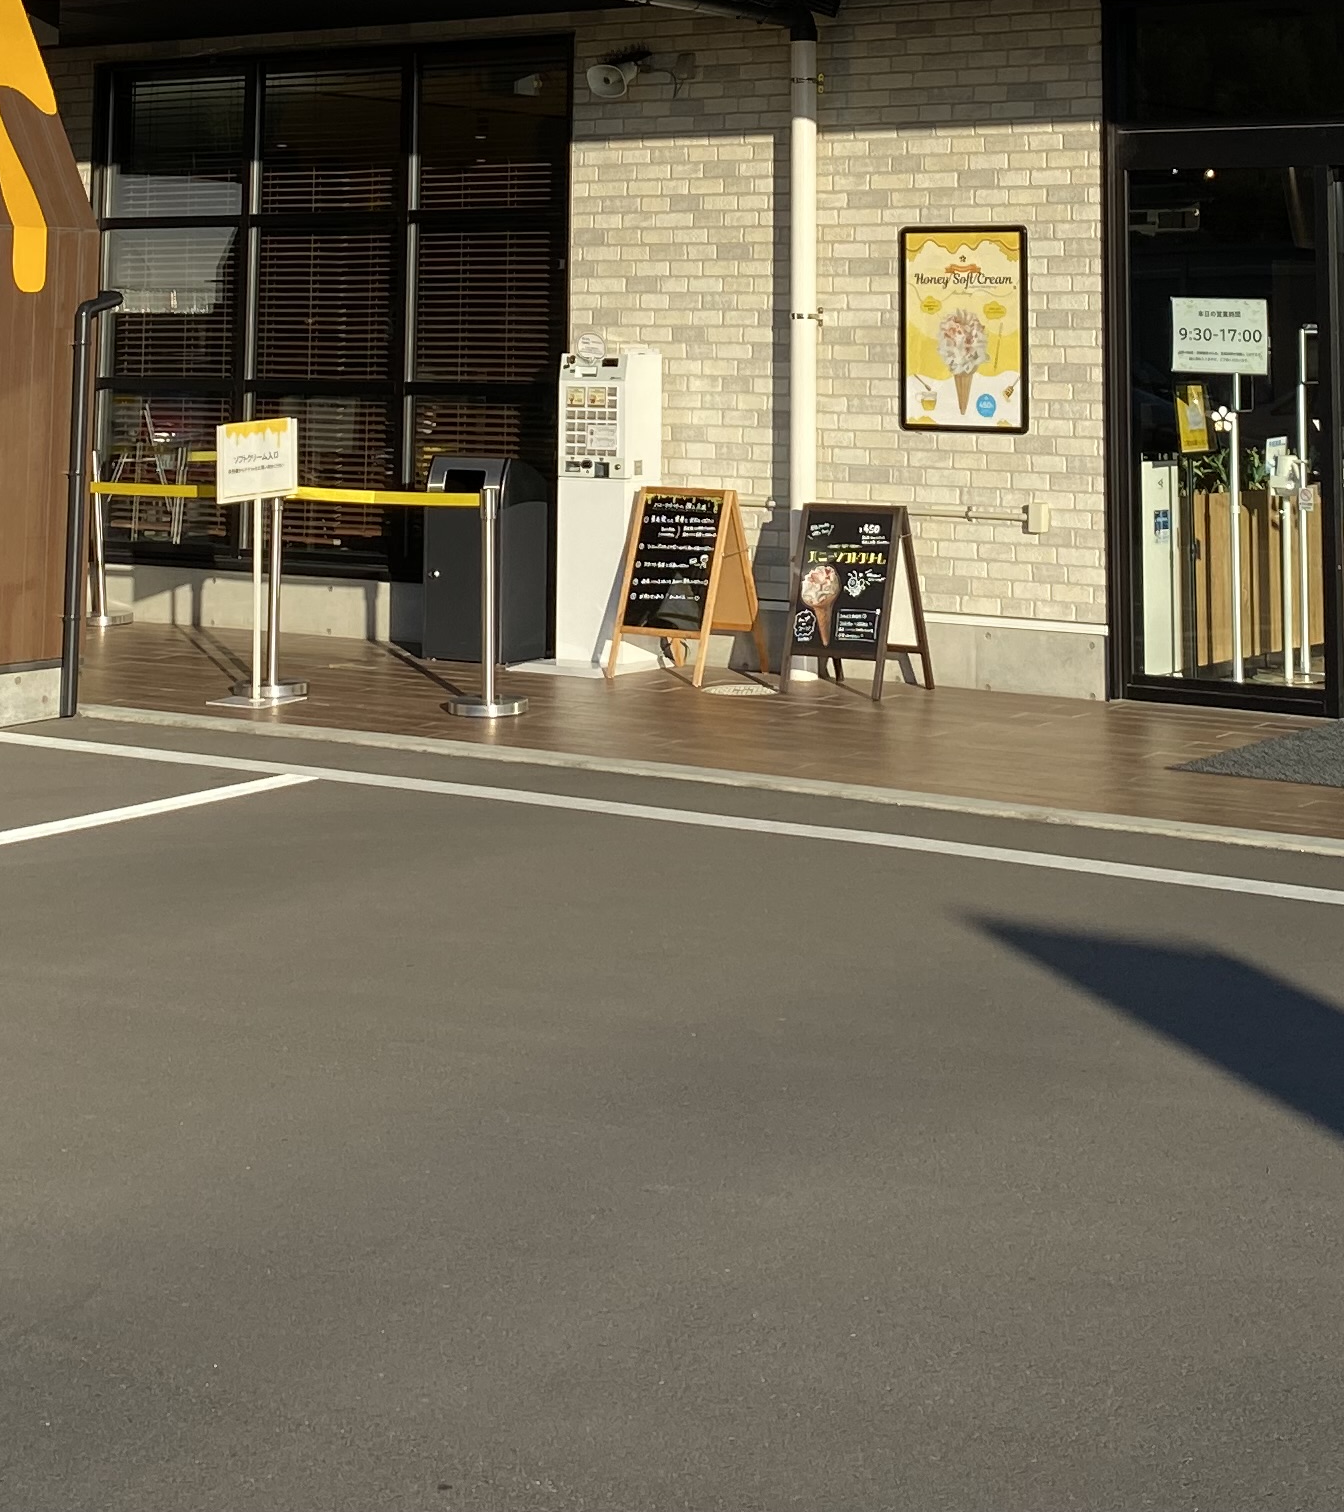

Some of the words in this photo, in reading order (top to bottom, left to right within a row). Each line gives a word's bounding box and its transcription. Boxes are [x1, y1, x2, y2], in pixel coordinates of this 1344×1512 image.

[914, 273, 950, 289] Honey
[952, 272, 975, 289] Soft
[976, 272, 1013, 285] Cream
[1178, 327, 1263, 343] 9:30-17:00
